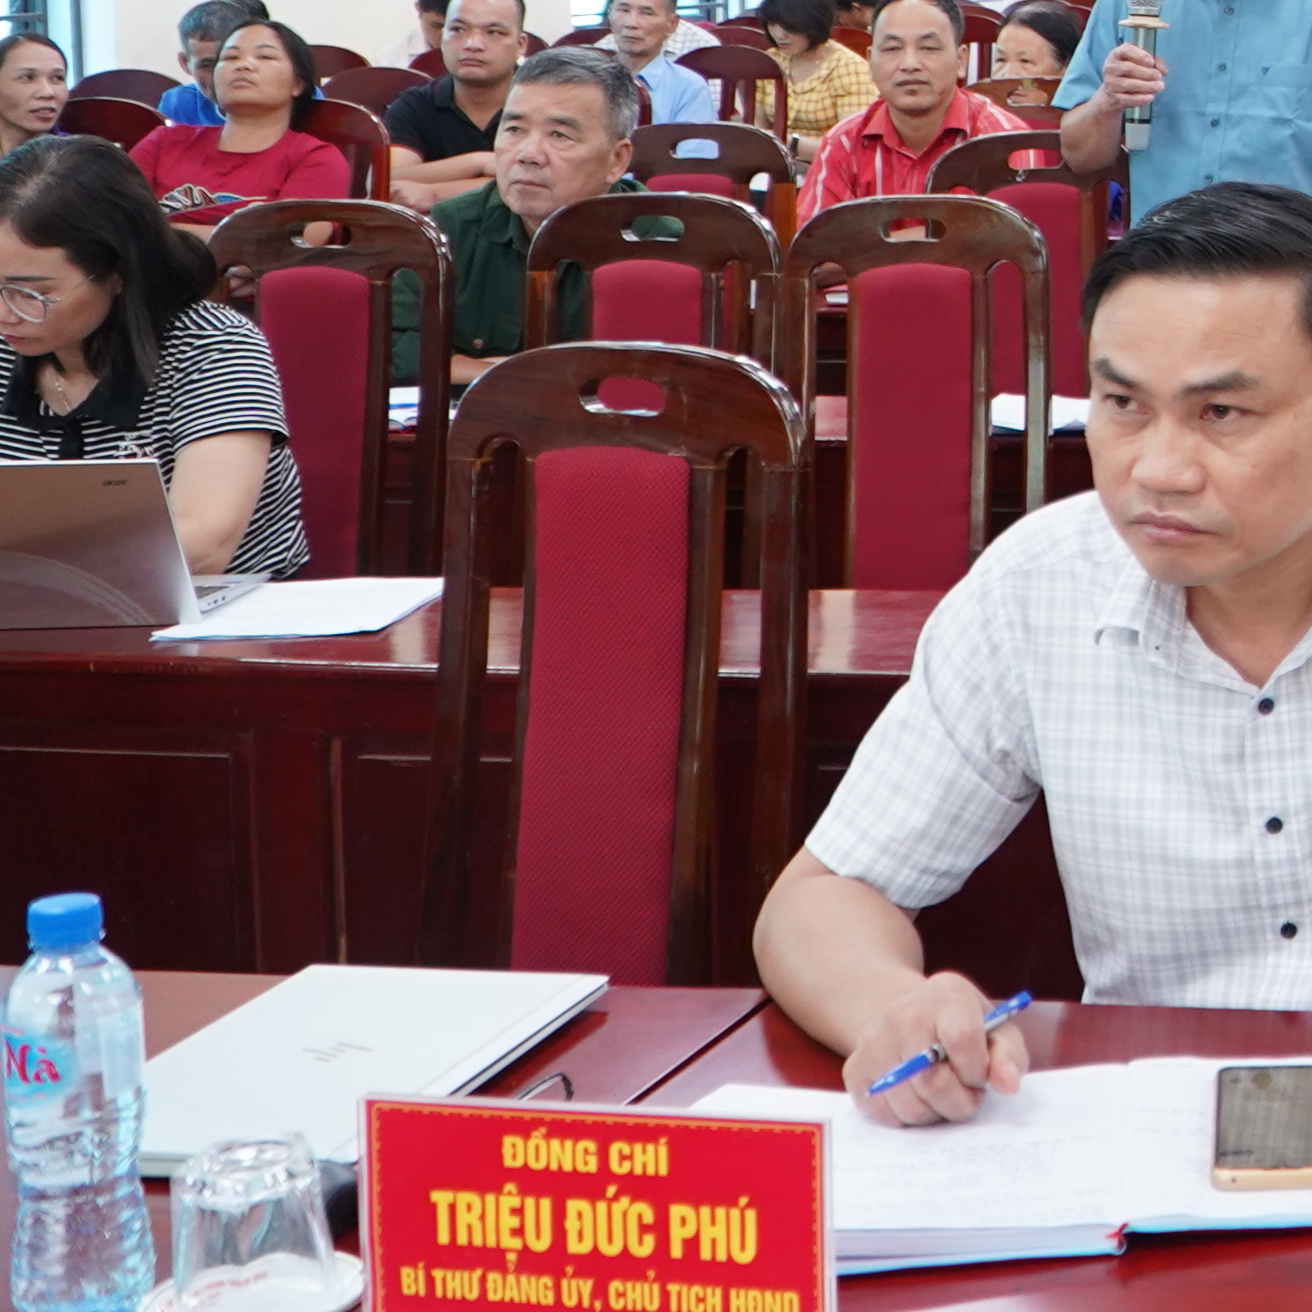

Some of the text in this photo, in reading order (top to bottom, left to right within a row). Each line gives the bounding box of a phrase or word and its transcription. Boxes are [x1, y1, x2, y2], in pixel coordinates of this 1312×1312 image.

[501, 1126, 669, 1177] ĐỒNG CHÍ
[429, 1182, 758, 1265] TRIỆU ĐỨC PHÚ
[399, 1261, 426, 1298] BÍ
[430, 1267, 484, 1301] THƯ
[485, 1262, 554, 1306] ĐẢNG
[607, 1269, 661, 1312] CHỦ
